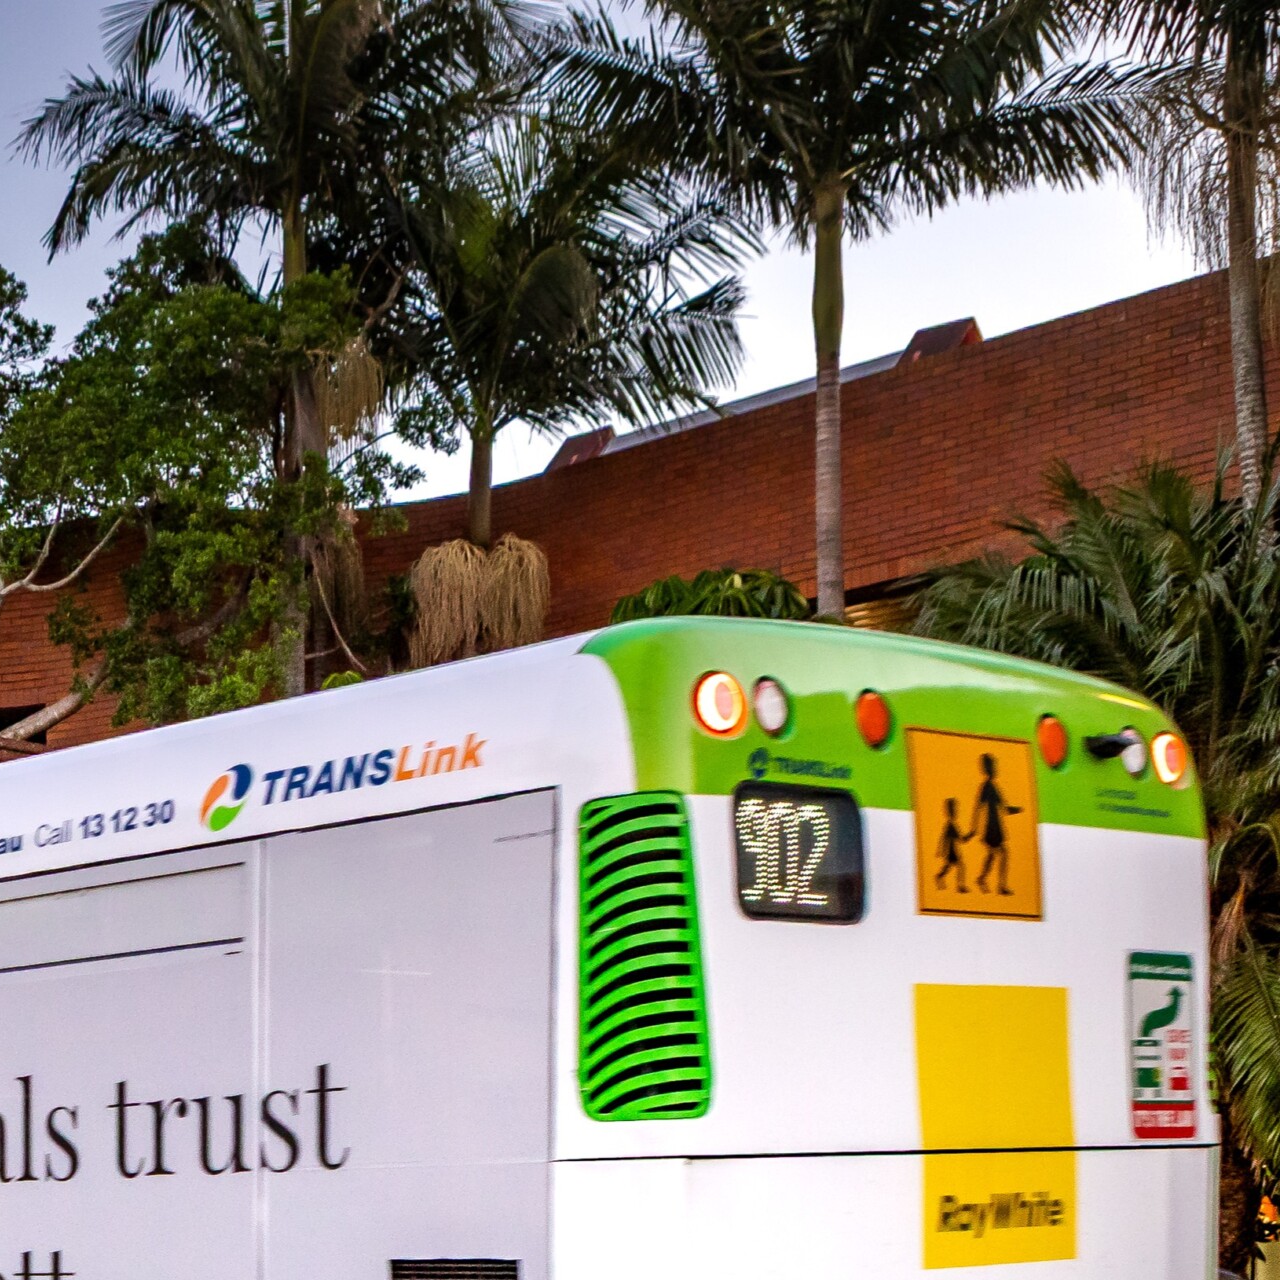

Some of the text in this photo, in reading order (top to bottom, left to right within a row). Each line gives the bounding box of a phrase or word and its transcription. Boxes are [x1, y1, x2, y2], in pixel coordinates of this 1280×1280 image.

[262, 732, 489, 806] TRANSLink
[34, 819, 73, 848] Call
[79, 813, 106, 840] 13
[111, 807, 138, 833] 12
[143, 799, 176, 828] 30
[106, 1063, 351, 1179] trust
